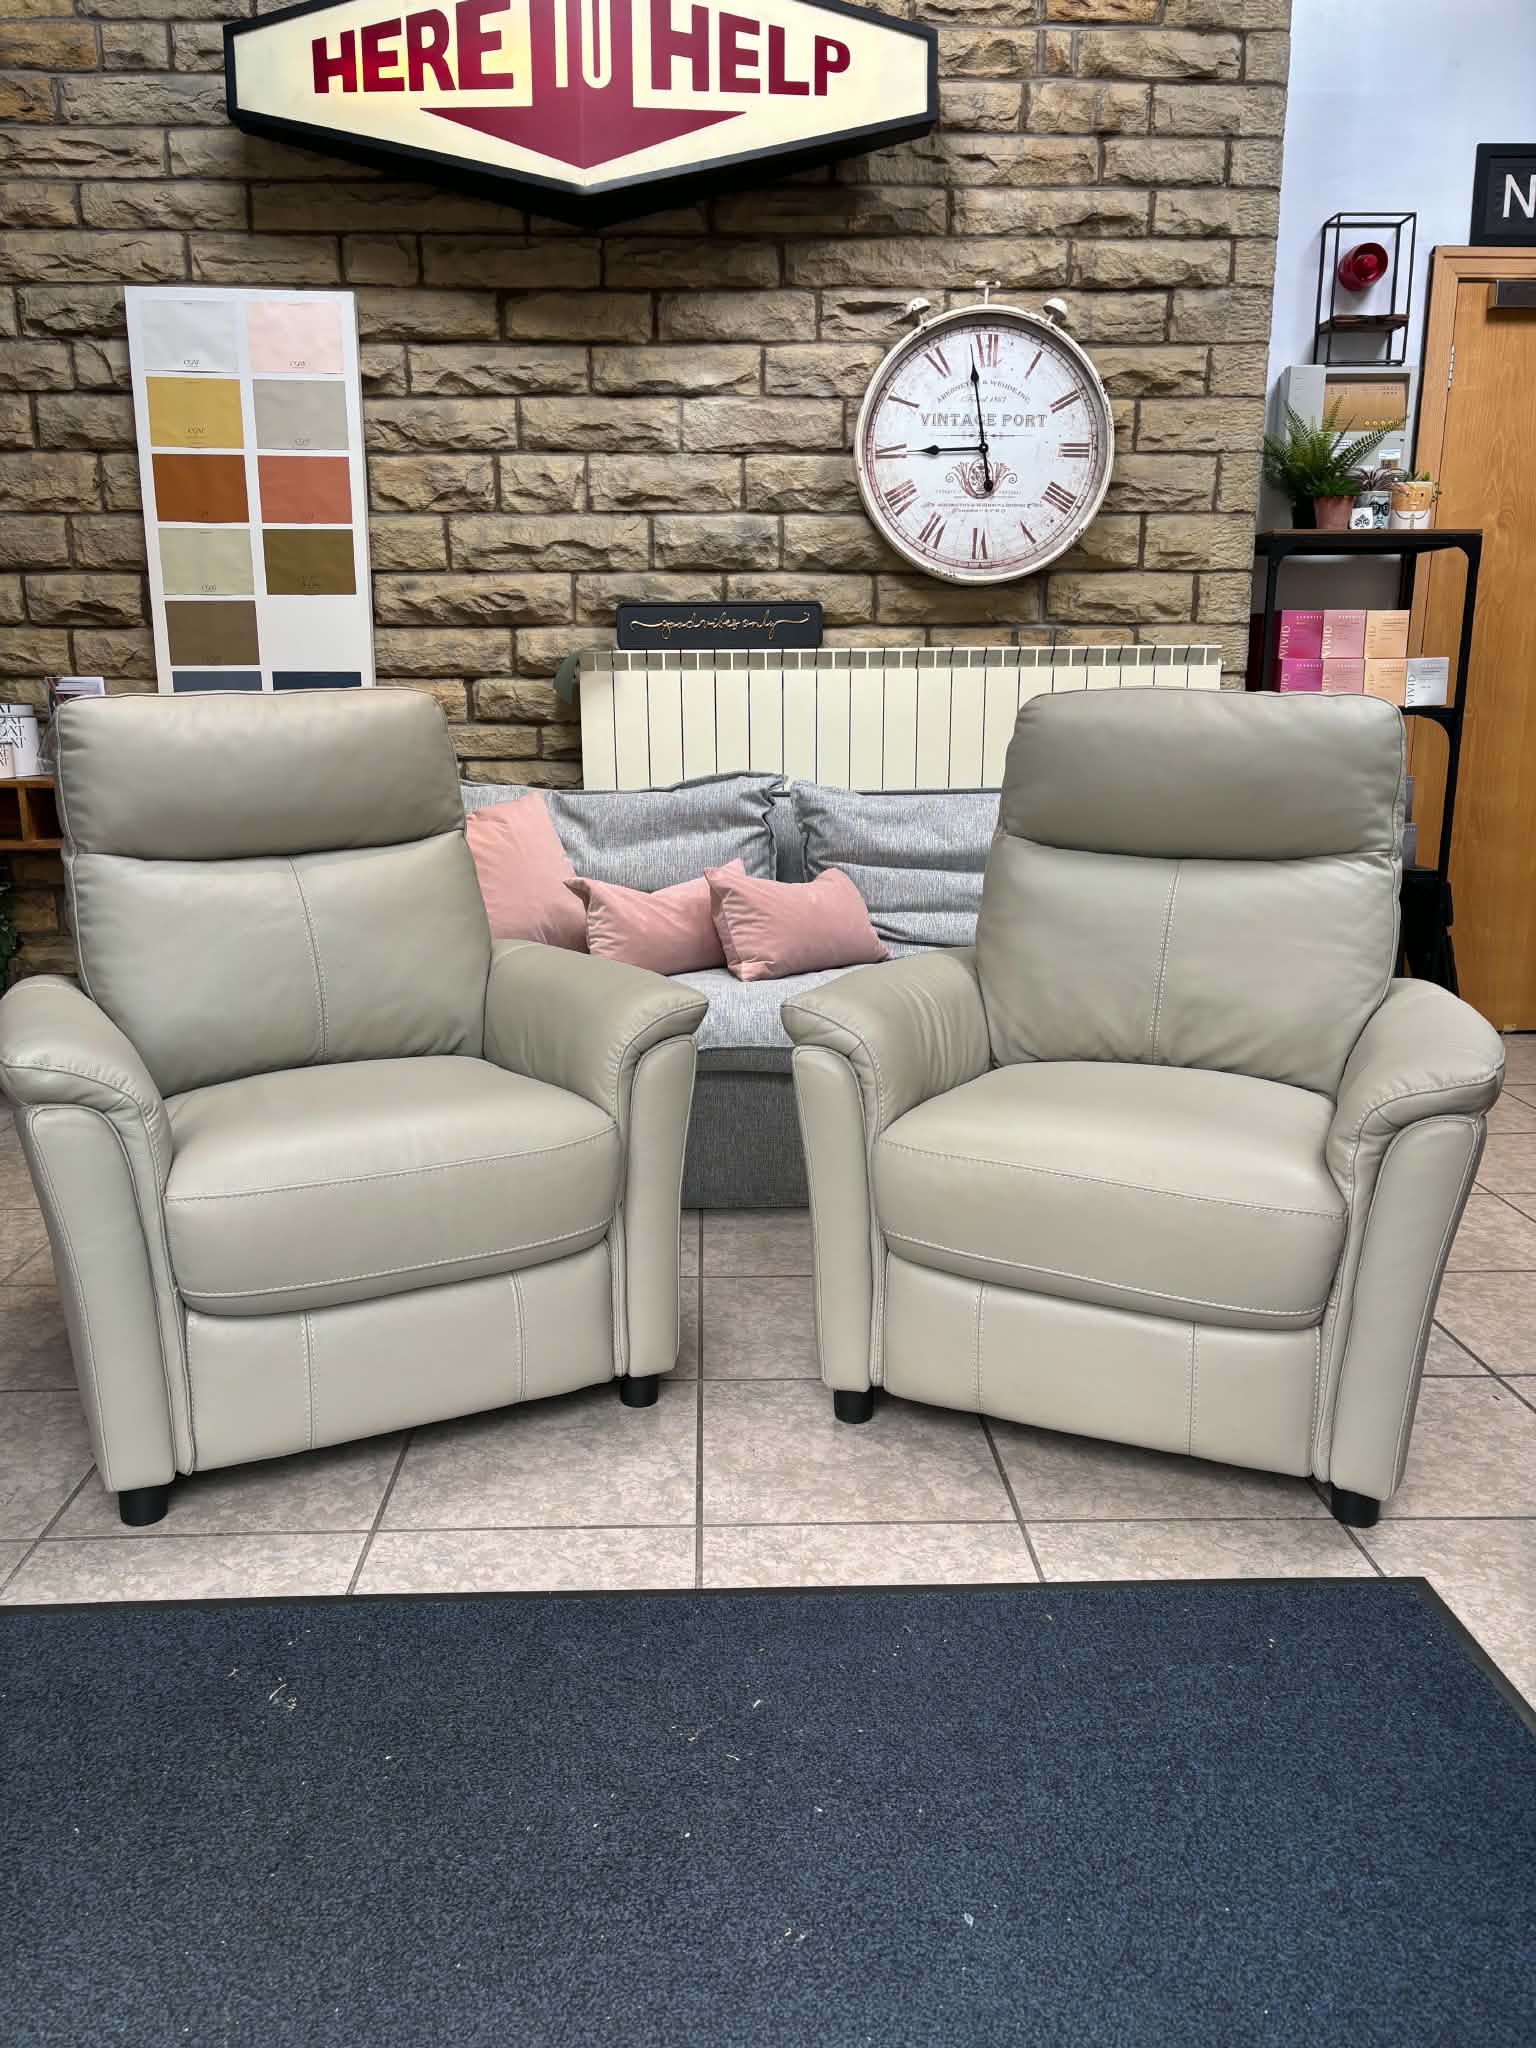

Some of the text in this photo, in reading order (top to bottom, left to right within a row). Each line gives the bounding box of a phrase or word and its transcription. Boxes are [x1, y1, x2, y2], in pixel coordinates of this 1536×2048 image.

[312, 0, 514, 94] HERE
[651, 0, 851, 96] HELP
[1502, 174, 1536, 218] N
[920, 413, 1048, 428] VINTAGE PORT
[642, 609, 790, 640] good vibes only
[1279, 625, 1291, 659] VIVID
[1322, 625, 1334, 658] VIVID
[1407, 674, 1417, 705] VIVID
